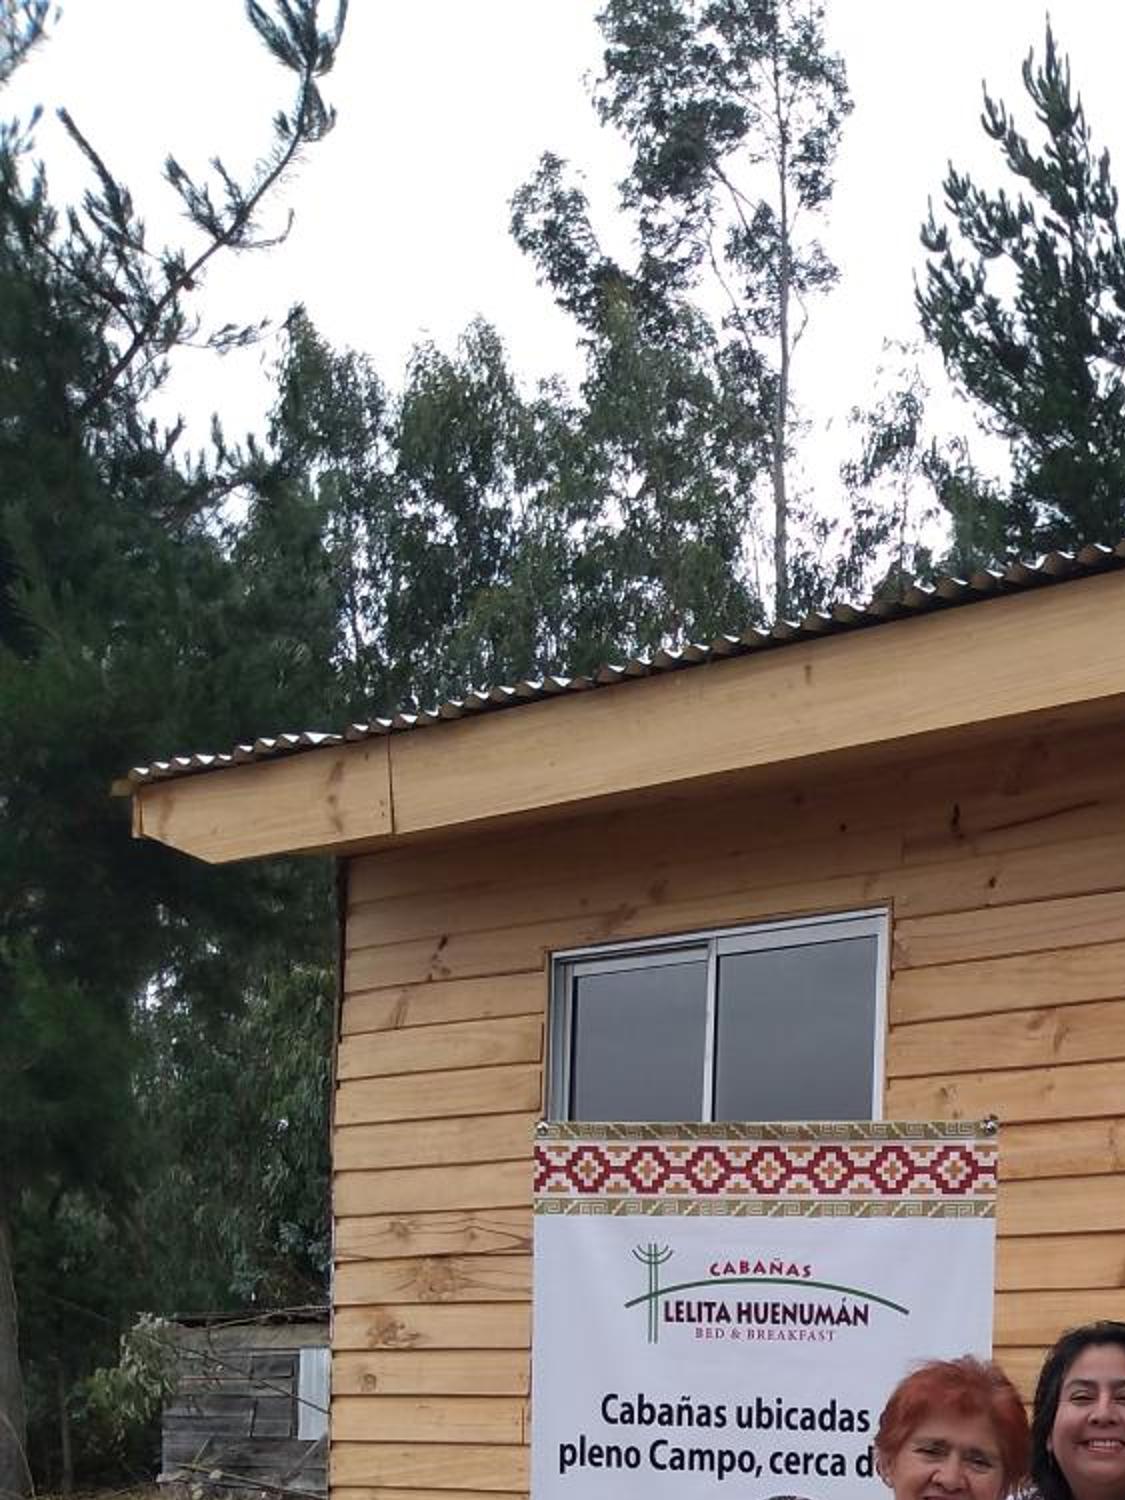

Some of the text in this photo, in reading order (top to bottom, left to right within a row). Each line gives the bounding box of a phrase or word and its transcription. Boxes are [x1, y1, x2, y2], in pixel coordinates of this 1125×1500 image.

[710, 1258, 812, 1278] CABAÑAS
[664, 1296, 869, 1327] LELITA HUENUMÁN
[695, 1327, 836, 1342] BED & BREAKFAST
[600, 1393, 871, 1433] Cabañas ubicadas
[558, 1435, 641, 1475] pleno
[649, 1439, 763, 1481] Campo,
[769, 1450, 847, 1477] cerca
